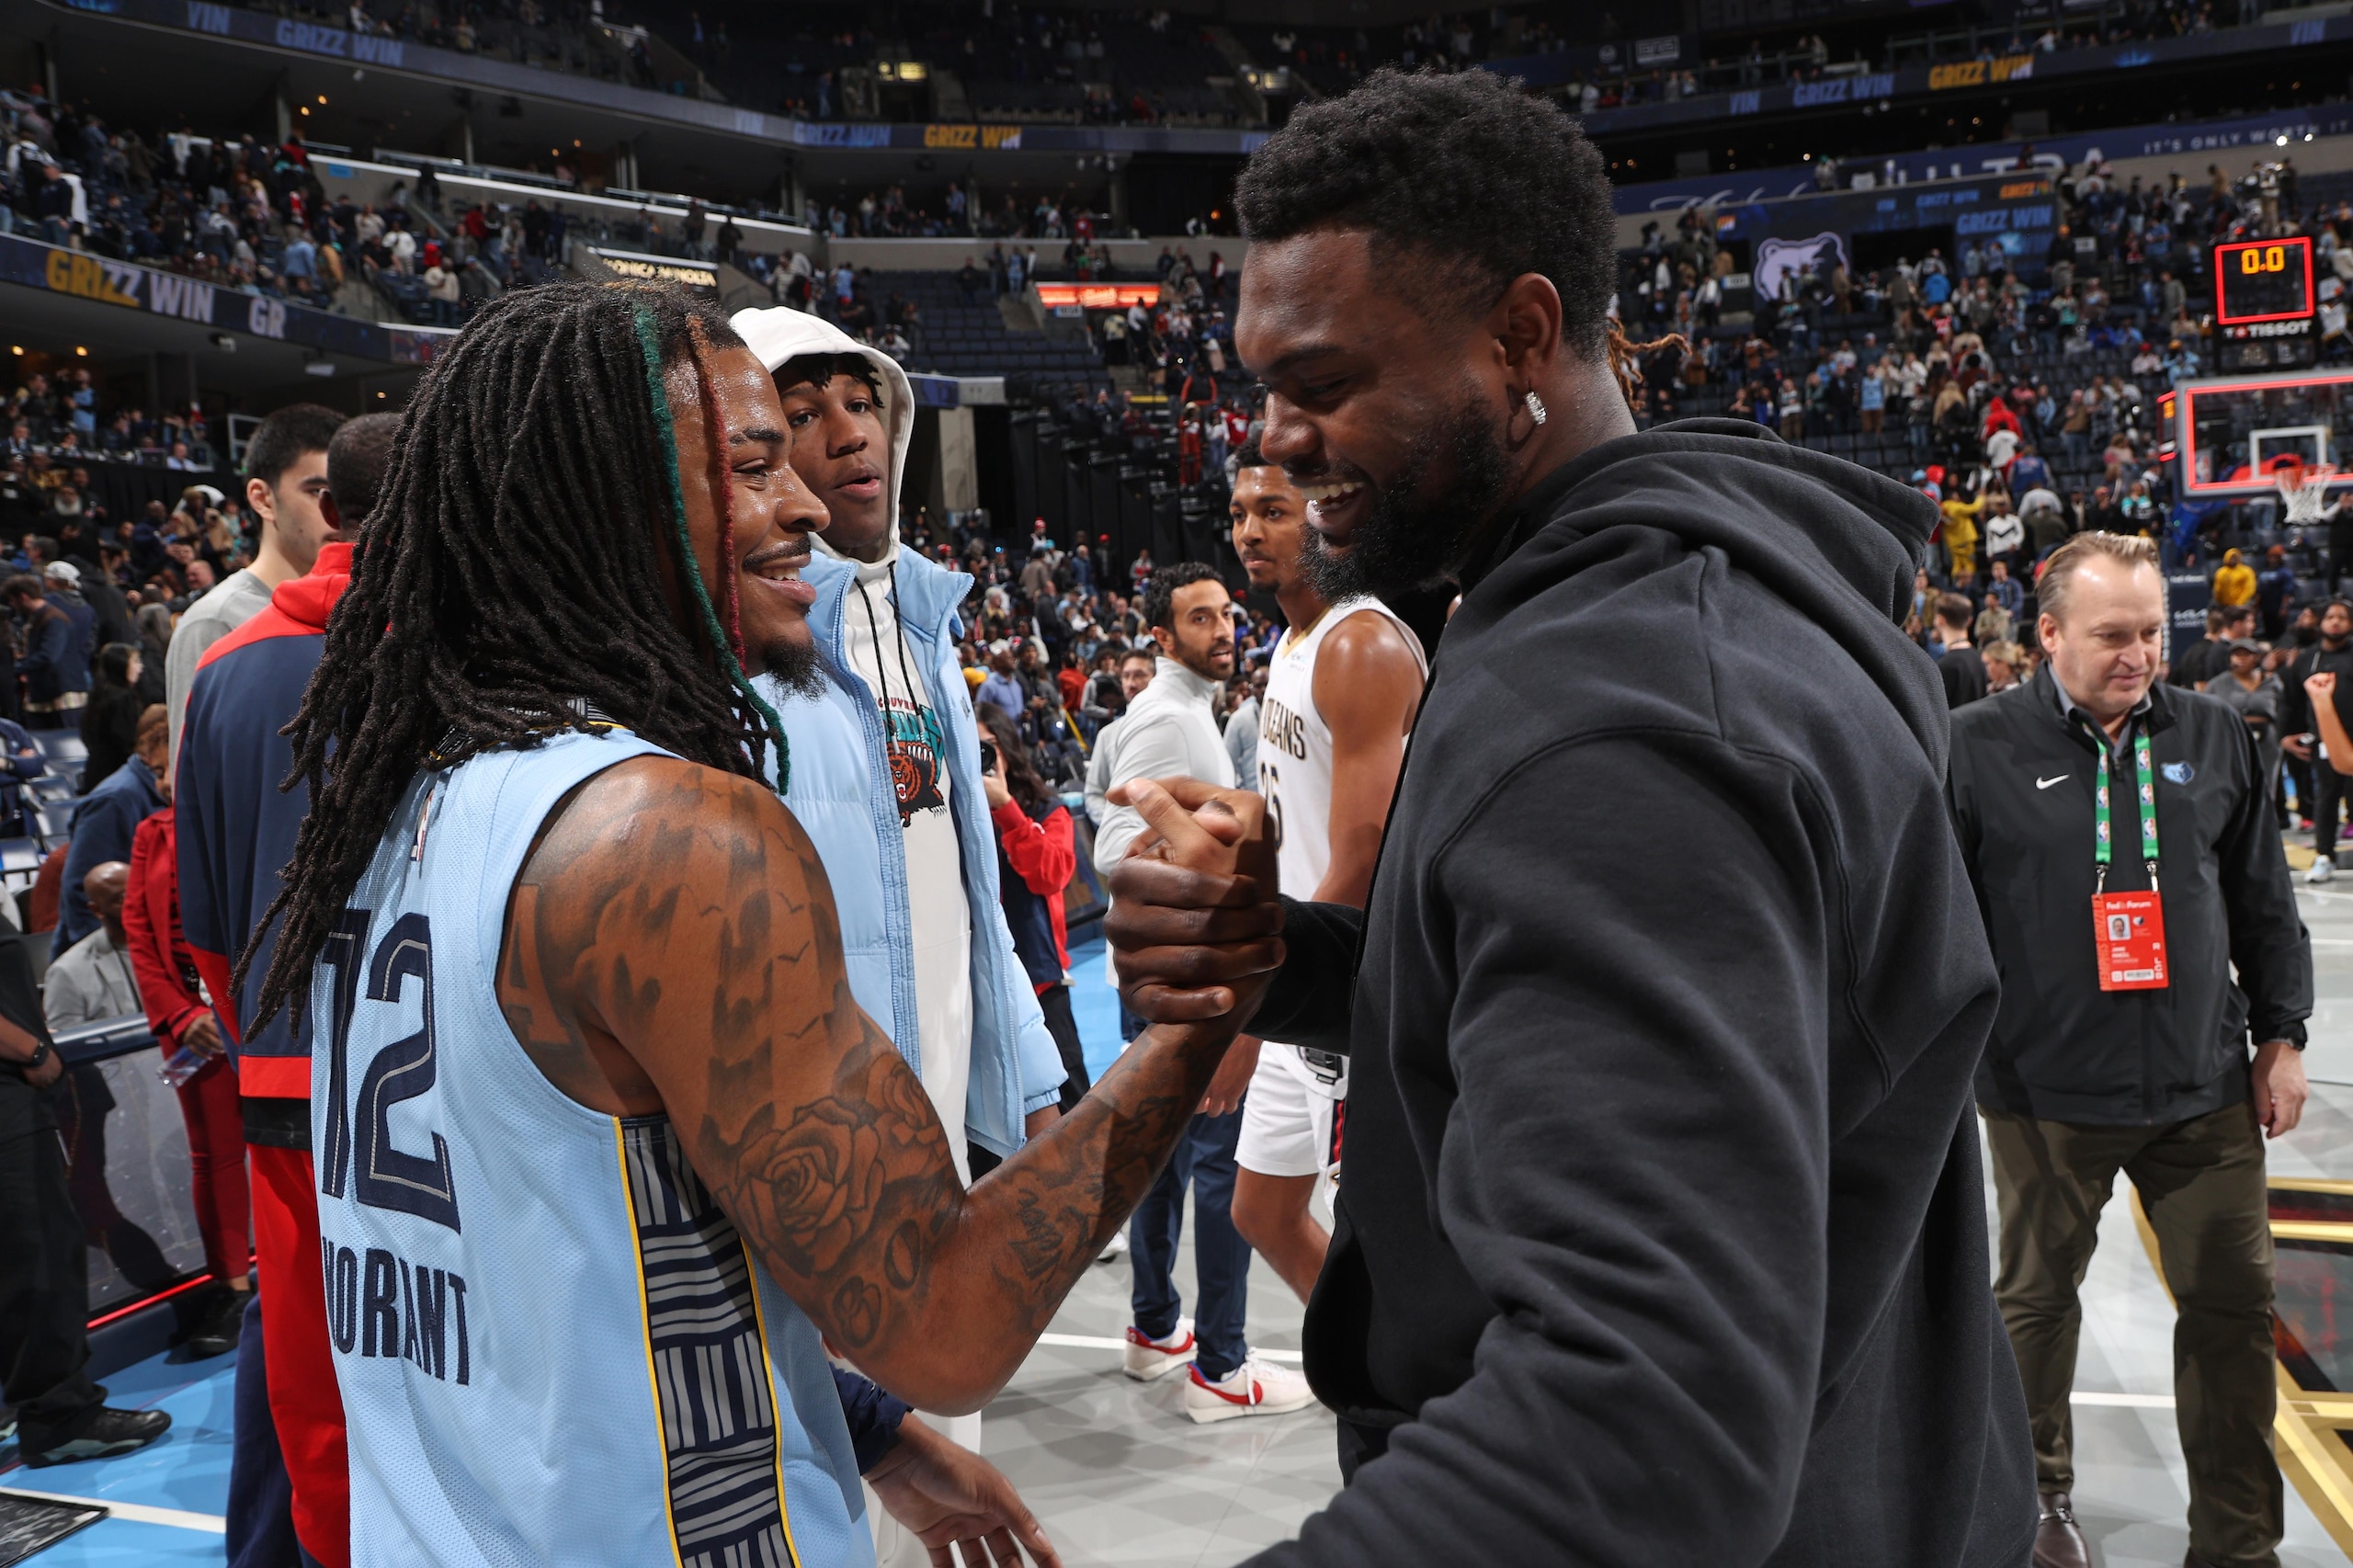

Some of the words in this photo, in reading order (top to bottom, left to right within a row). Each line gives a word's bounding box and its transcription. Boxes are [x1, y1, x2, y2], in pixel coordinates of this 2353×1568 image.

[277, 17, 346, 56] GRIZZ
[352, 33, 404, 67] WIN
[1929, 61, 1985, 90] GRIZZ
[1989, 55, 2035, 83] WIN
[1792, 77, 1848, 108] GRIZZ
[1851, 73, 1895, 99] WIN
[924, 125, 978, 148] GRIZZ
[981, 126, 1022, 149] WIN
[2143, 138, 2182, 155] IT'S
[2190, 131, 2241, 151] ONLY
[1957, 209, 2008, 235] GRIZZ
[2013, 204, 2052, 229] WIN
[2241, 245, 2285, 275] 0.0
[47, 249, 141, 307] GRIZZ
[149, 272, 215, 324] WIN
[2248, 320, 2313, 337] TISSOT
[321, 908, 462, 1235] 12
